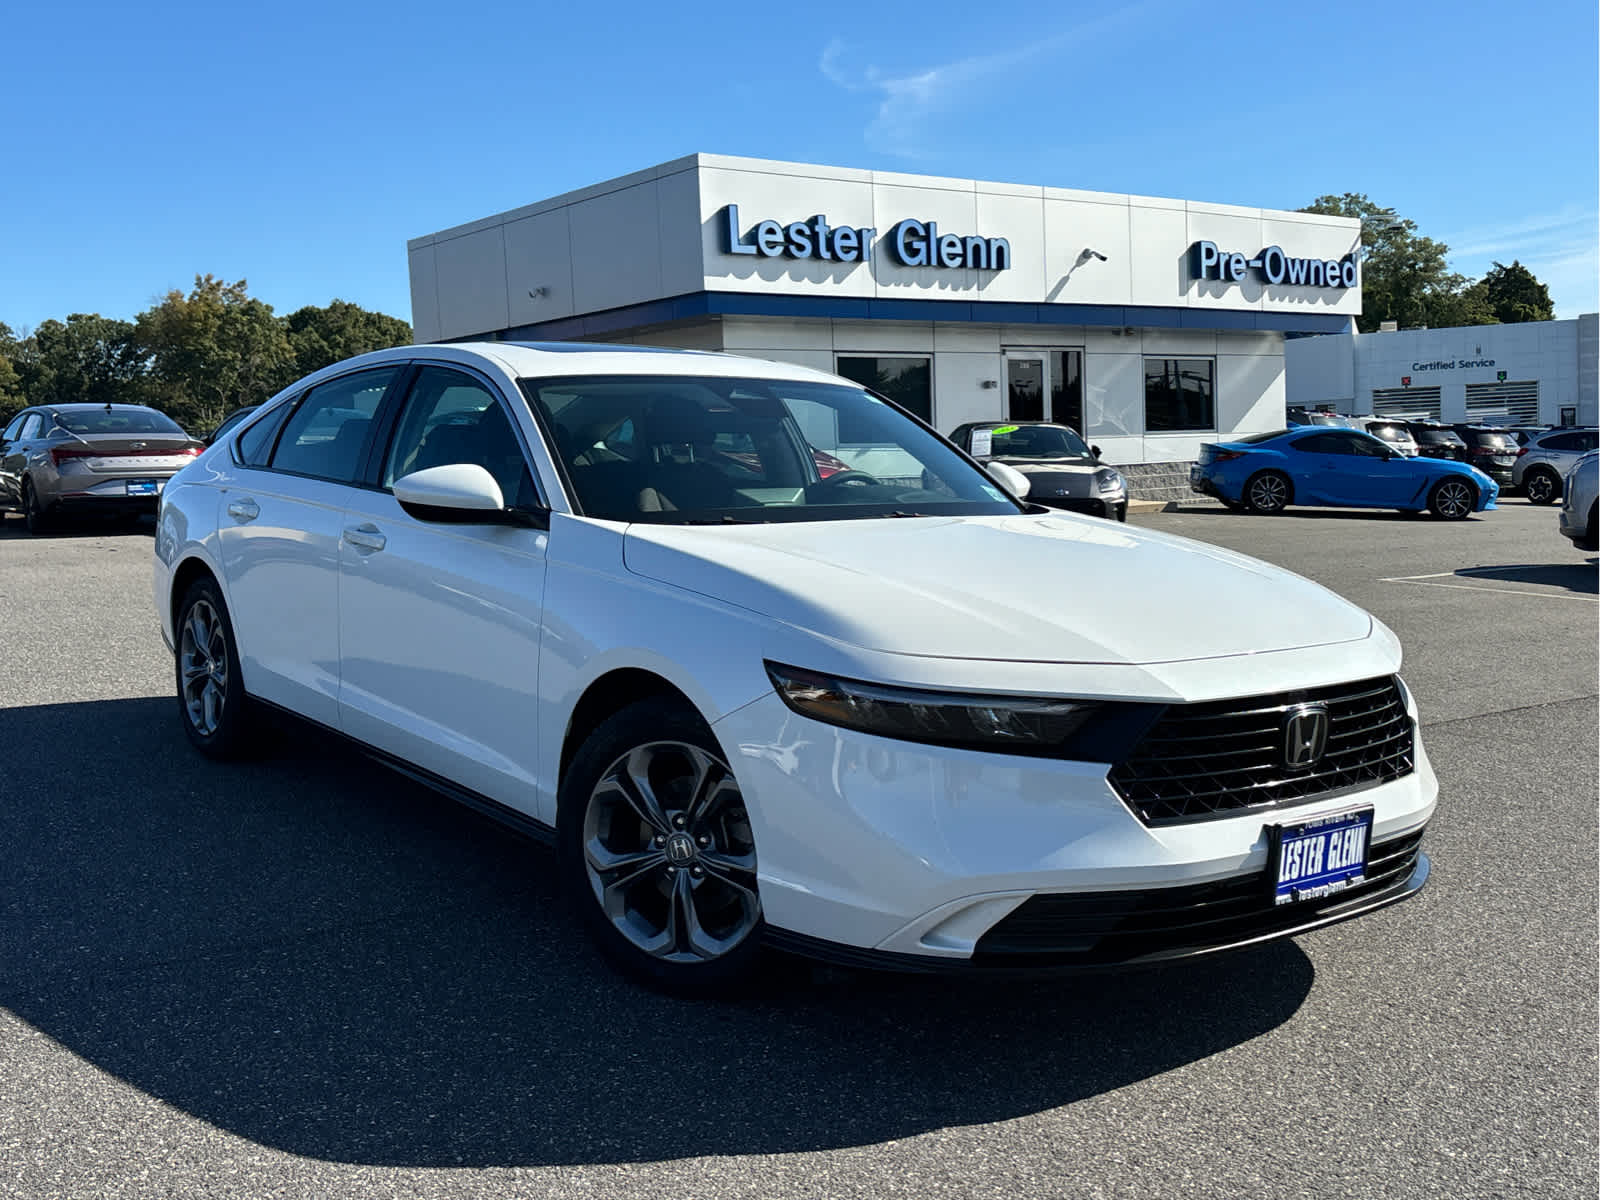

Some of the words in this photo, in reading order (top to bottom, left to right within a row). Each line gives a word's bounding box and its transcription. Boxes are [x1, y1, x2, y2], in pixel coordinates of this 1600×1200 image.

[724, 203, 877, 263] Lester
[895, 217, 1011, 270] Glenn
[1195, 240, 1358, 289] Pre-Owned
[1412, 360, 1455, 372] Certified
[1458, 357, 1496, 369] Service
[1279, 835, 1325, 883] LESTER
[1327, 826, 1367, 871] GLENN
